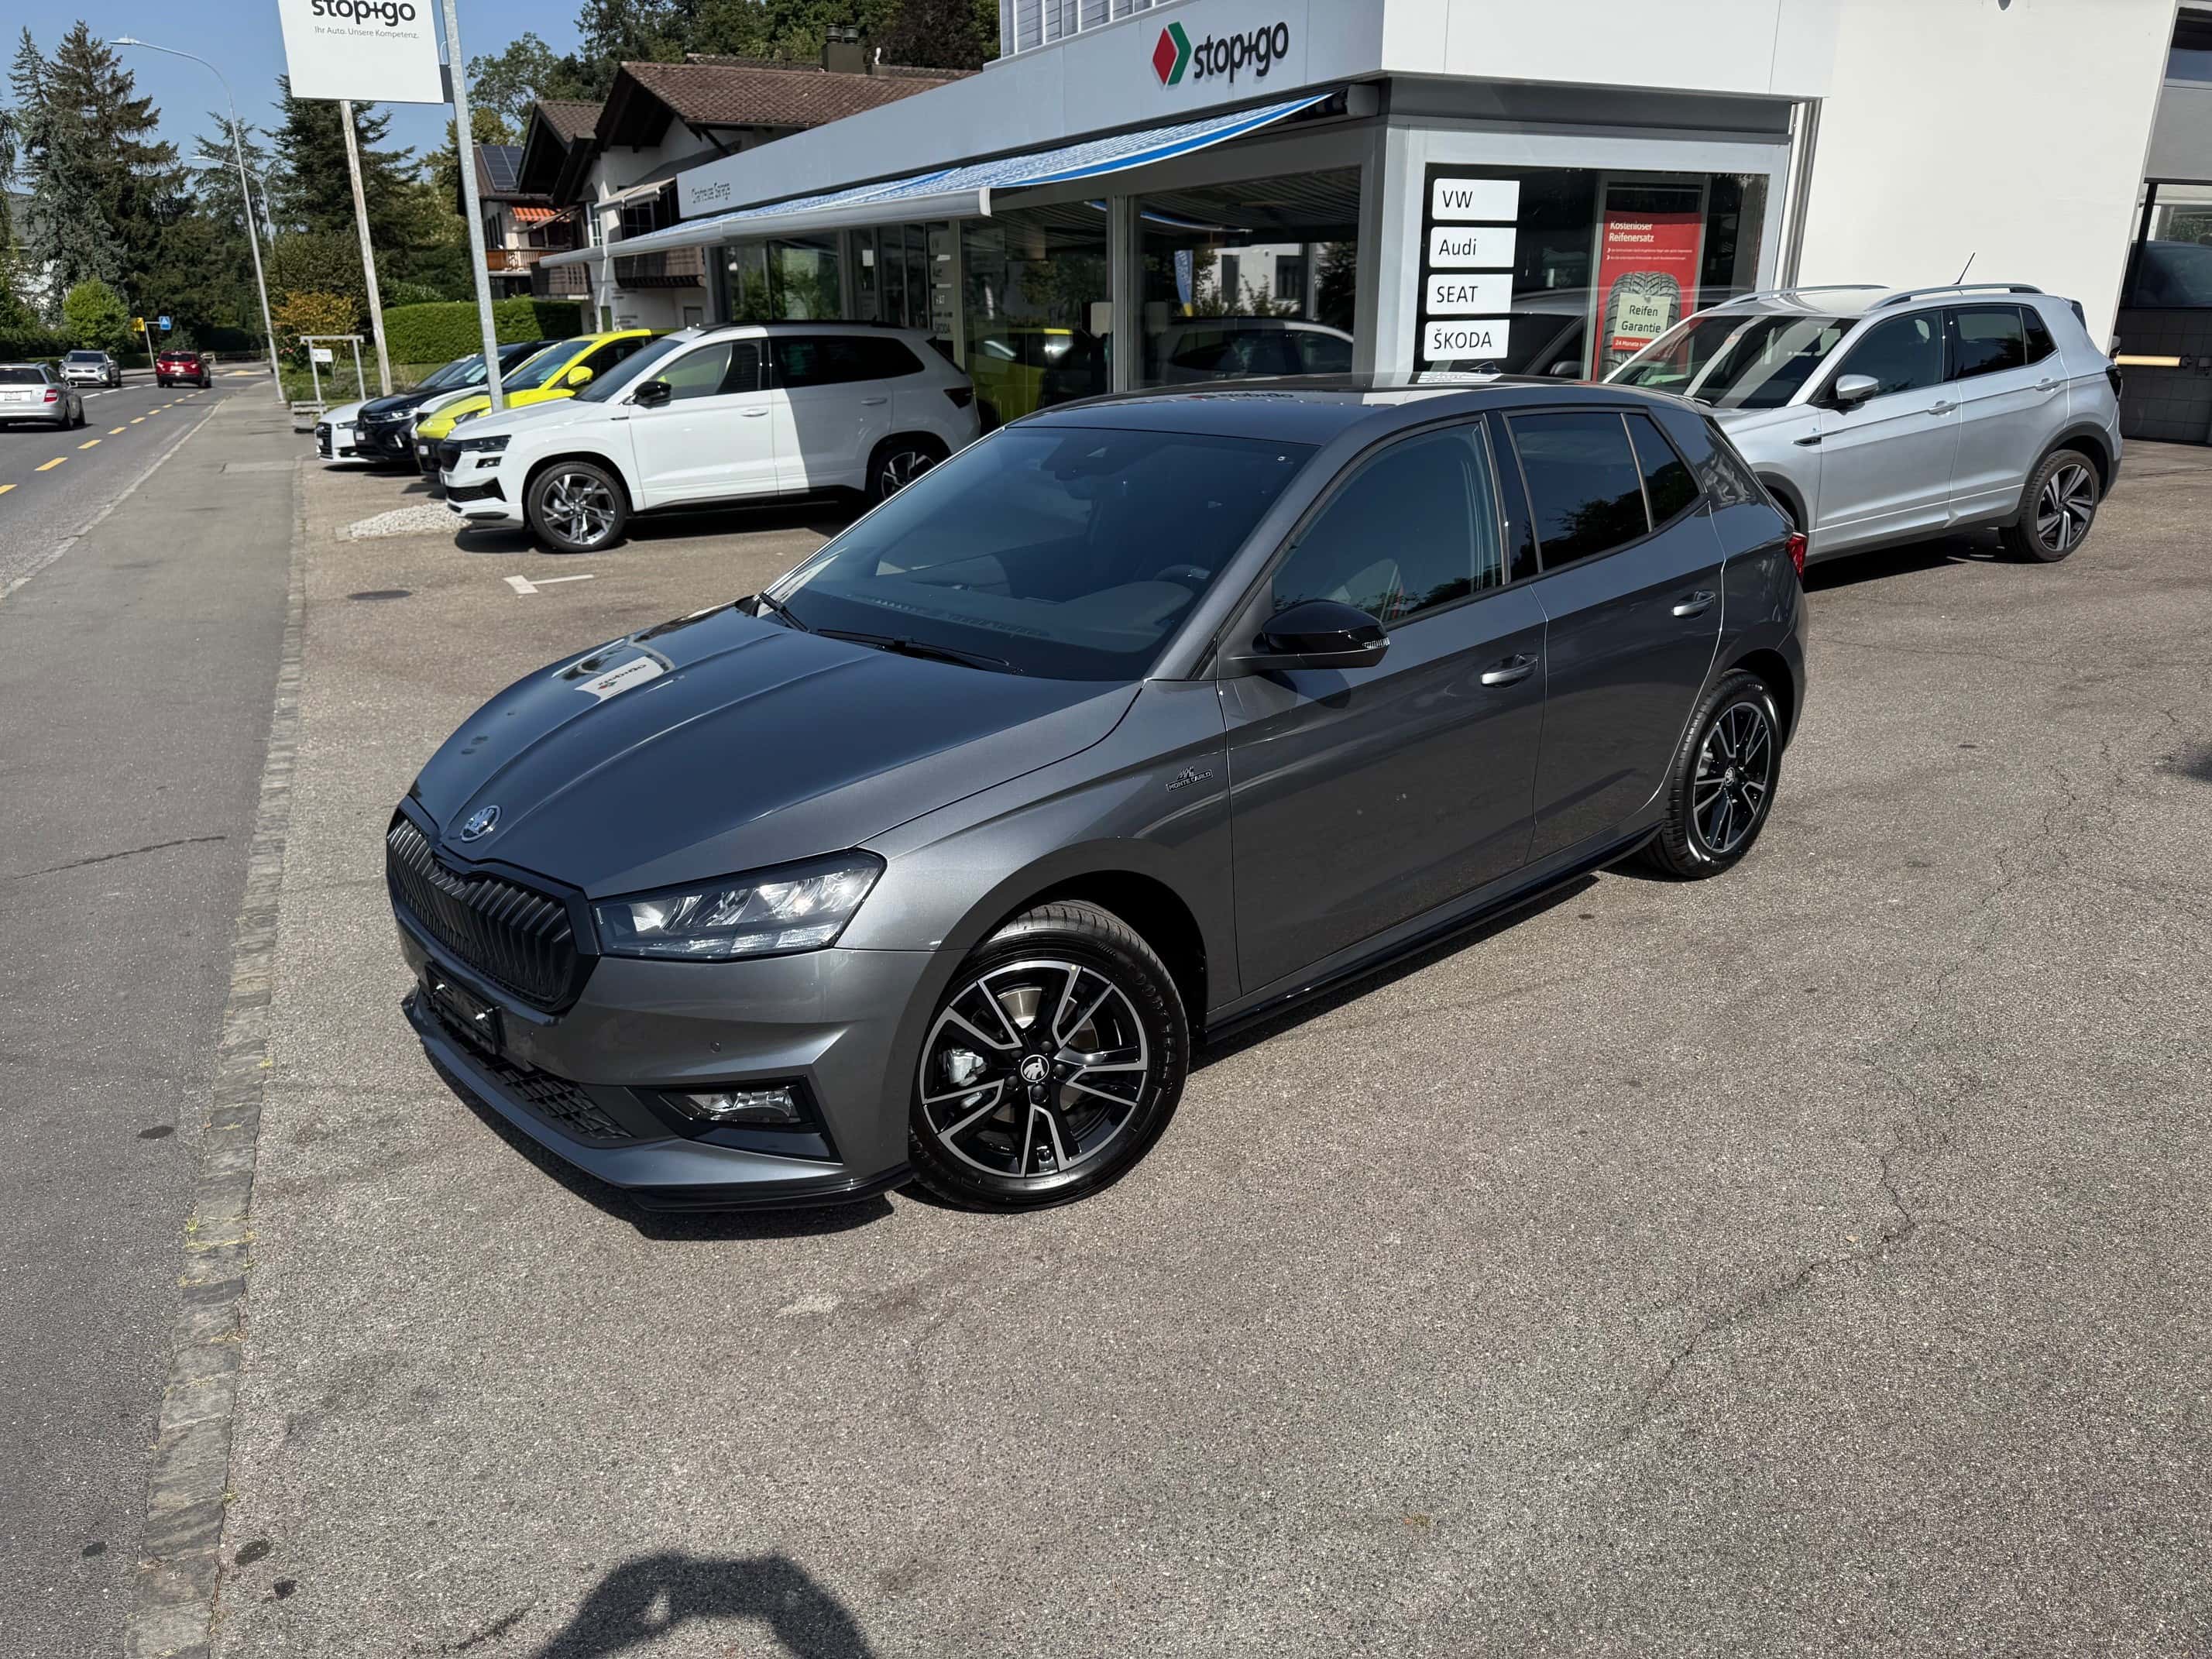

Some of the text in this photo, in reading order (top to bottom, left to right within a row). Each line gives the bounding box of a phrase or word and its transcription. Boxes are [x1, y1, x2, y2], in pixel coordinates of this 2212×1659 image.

[311, 0, 416, 26] stop+go
[348, 28, 373, 36] Unsere
[375, 29, 419, 39] Kompetenz.
[1194, 22, 1289, 83] stop+go
[1442, 190, 1473, 208] VW
[1610, 220, 1653, 230] Kostenloser
[1609, 232, 1654, 242] Reifenersatz
[1438, 237, 1477, 256] Audi
[1436, 285, 1479, 303] SEAT
[1629, 304, 1657, 317] Reifen
[1621, 321, 1661, 333] Garantie
[1433, 328, 1492, 349] ŠKODA
[1169, 771, 1211, 790] MONTE CARLO
